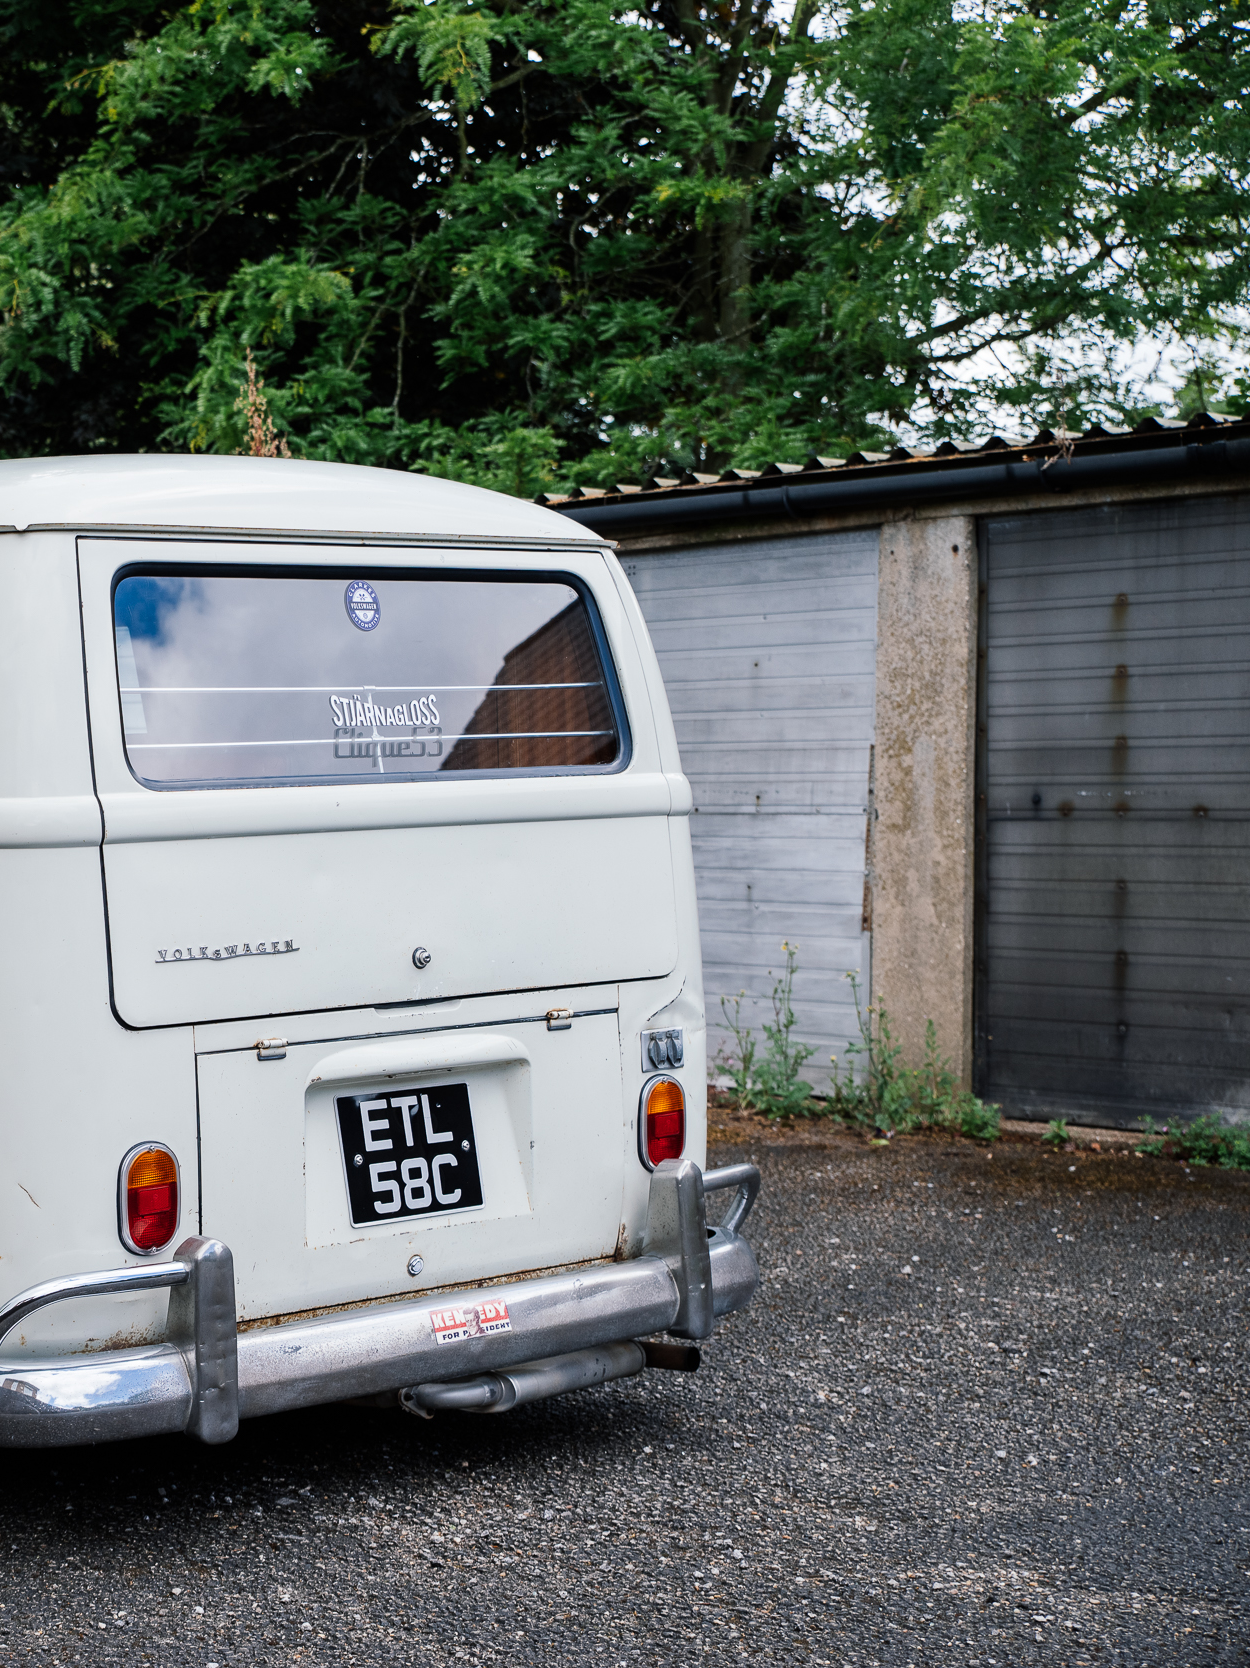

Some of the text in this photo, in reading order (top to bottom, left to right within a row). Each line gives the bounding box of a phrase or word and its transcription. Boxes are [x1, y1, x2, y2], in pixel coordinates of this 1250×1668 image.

[351, 613, 379, 629] AUTOMOTIVE
[330, 694, 440, 727] STJÄRNAGLOSS
[333, 726, 443, 768] Clique53
[359, 1094, 454, 1152] ETL
[368, 1153, 462, 1214] 58C
[431, 1301, 506, 1329] KENEDY
[442, 1331, 460, 1341] FOR
